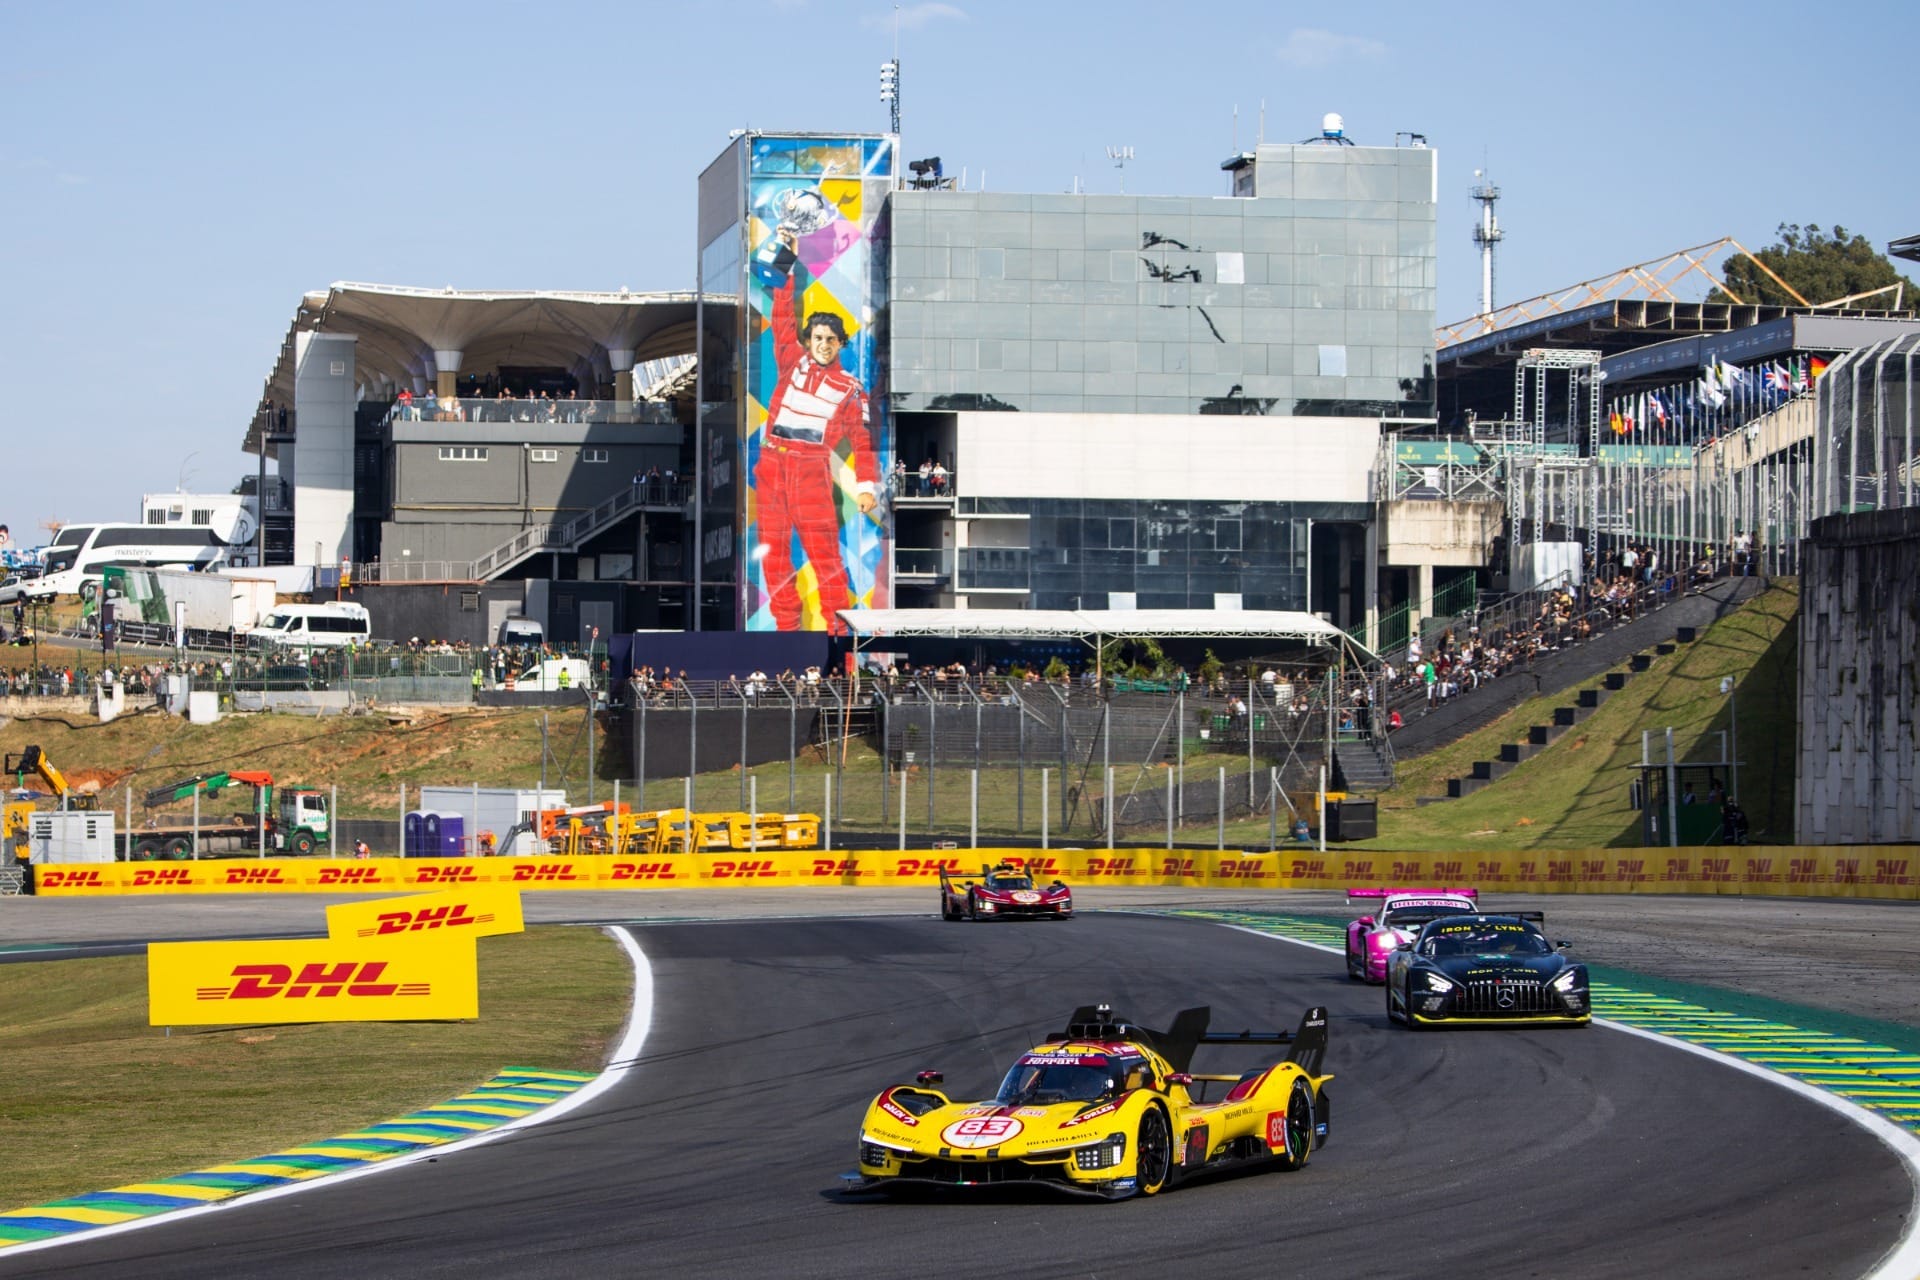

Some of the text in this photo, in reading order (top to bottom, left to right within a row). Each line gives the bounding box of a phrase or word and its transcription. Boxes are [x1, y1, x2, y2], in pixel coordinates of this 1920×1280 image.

[318, 867, 381, 884] DHL
[416, 866, 478, 883] DHL
[512, 864, 577, 881] DHL
[611, 863, 676, 879] DHL
[711, 861, 778, 878] DHL
[896, 859, 963, 876] DHL
[1087, 858, 1136, 876] DHL
[1219, 860, 1266, 878] DHL
[1291, 860, 1326, 879] DHL
[1345, 861, 1374, 880] DHL
[1392, 862, 1421, 881] DHL
[1434, 862, 1464, 881] DHL
[1519, 861, 1536, 881] DL
[1617, 860, 1646, 881] DHL
[1701, 859, 1731, 881] DHL
[1876, 859, 1910, 885] DHL
[43, 871, 103, 887] DHL
[133, 869, 193, 886] DHL
[226, 868, 284, 884] DHL
[377, 904, 475, 935] DHL
[1441, 925, 1471, 933] IRON
[229, 961, 398, 999] DHL
[1025, 1057, 1080, 1065] Ferrari
[1083, 1105, 1116, 1120] ORLEN
[957, 1120, 1009, 1135] 83
[1271, 1117, 1284, 1142] 83
